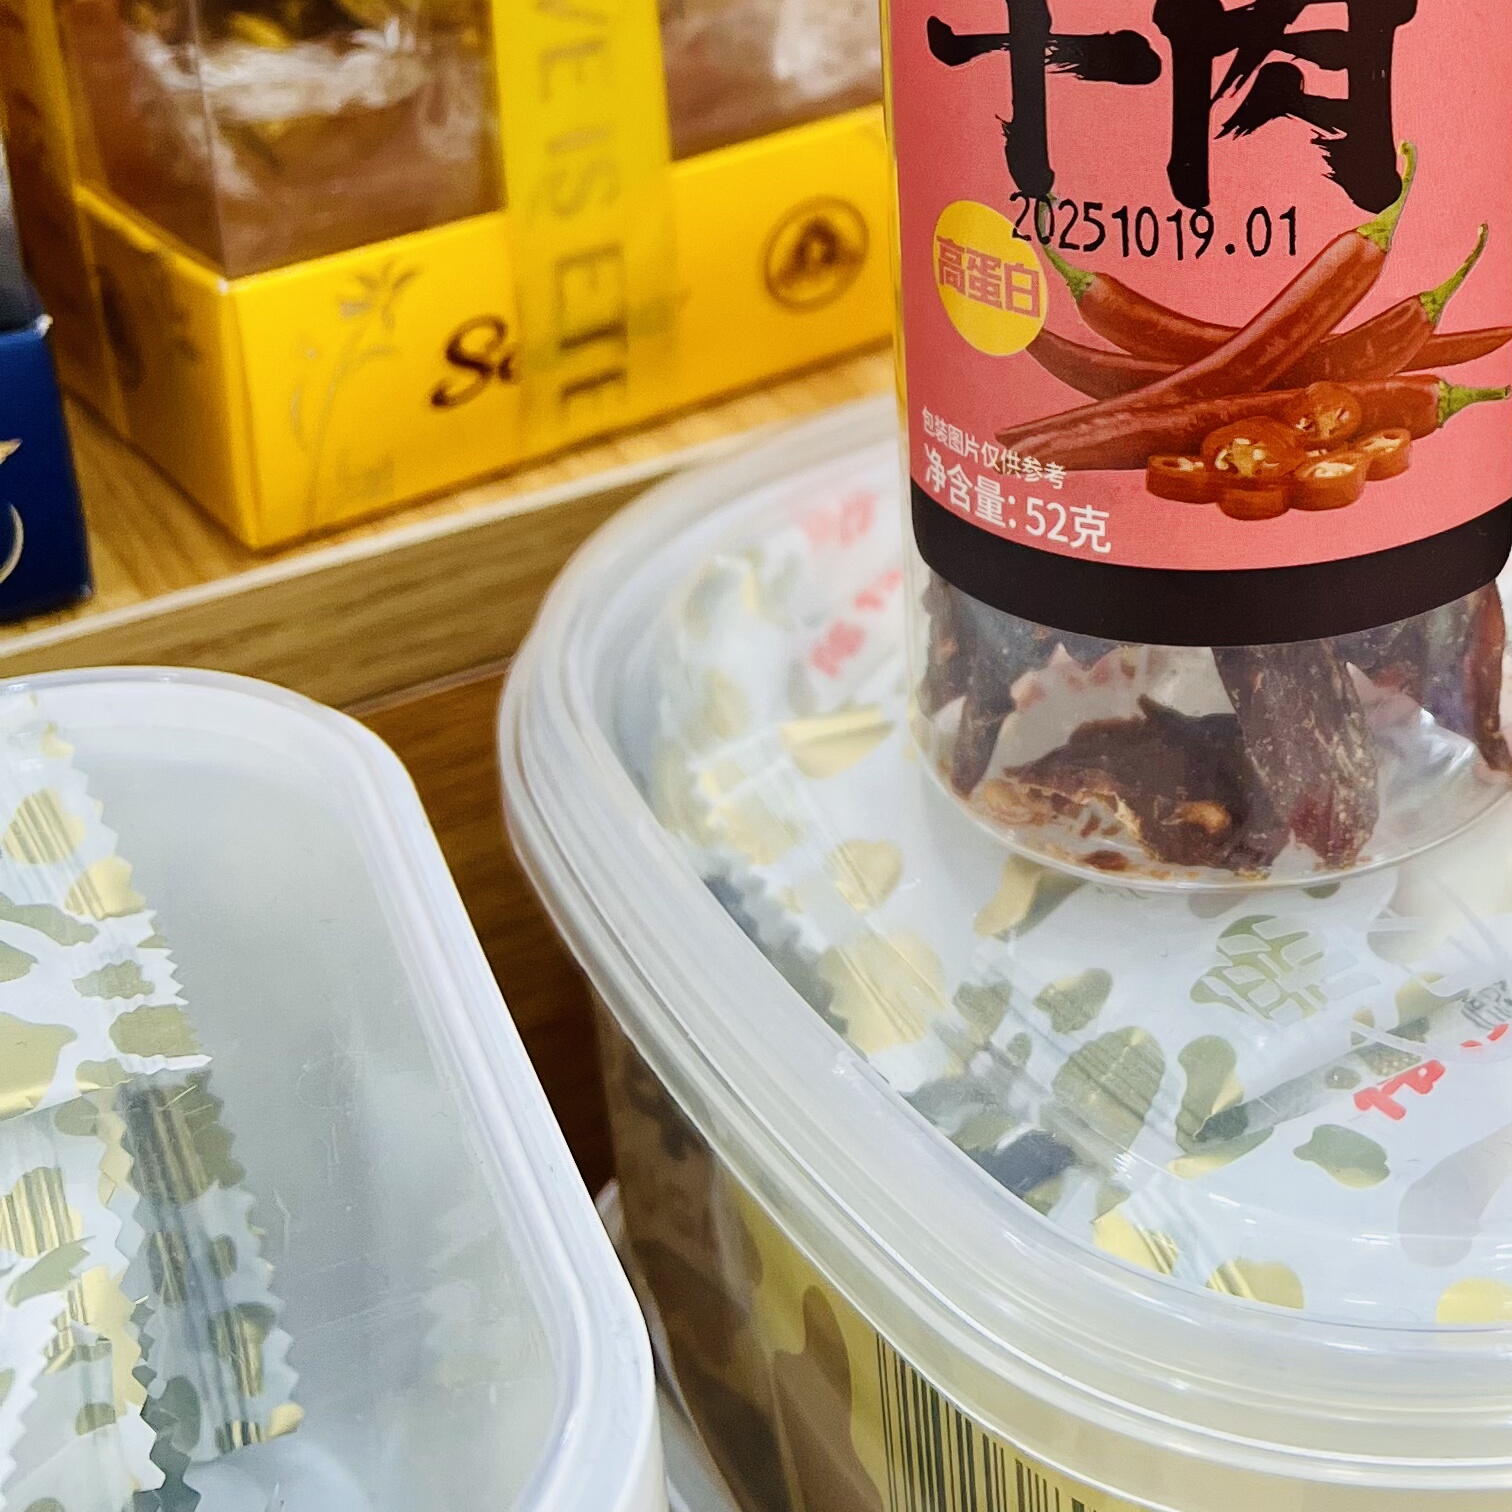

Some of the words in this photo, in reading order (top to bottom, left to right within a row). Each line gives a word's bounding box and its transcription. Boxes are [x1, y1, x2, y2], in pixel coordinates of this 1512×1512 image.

[1009, 191, 1297, 261] 20251019.01
[936, 235, 1041, 318] 高蛋白
[922, 404, 1068, 490] 包装图片仅供参考
